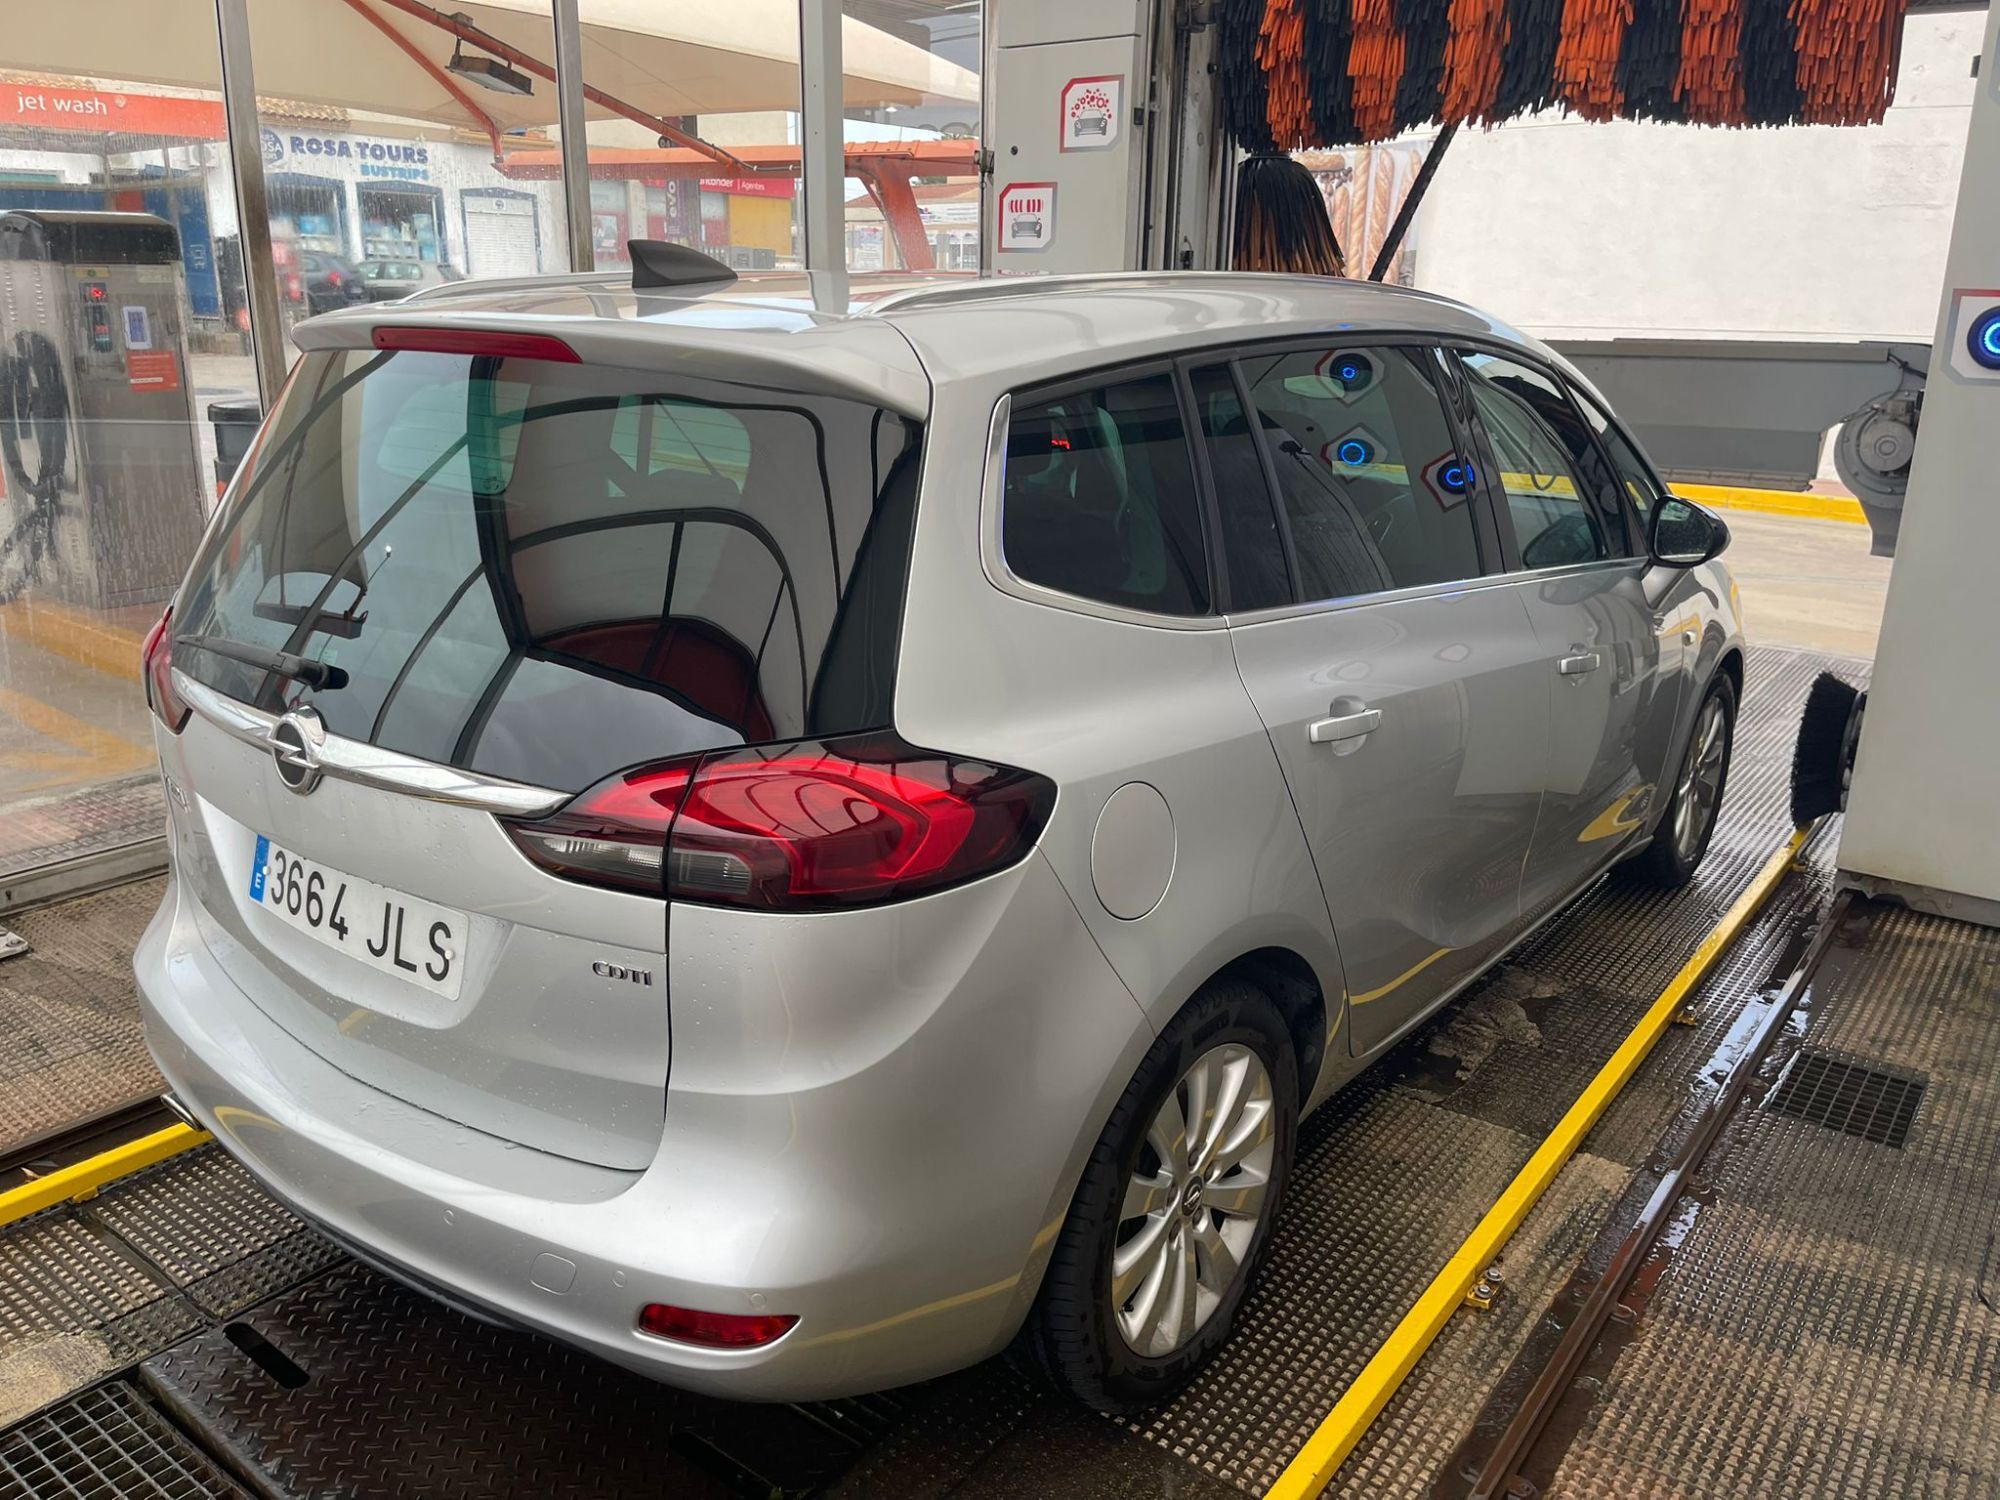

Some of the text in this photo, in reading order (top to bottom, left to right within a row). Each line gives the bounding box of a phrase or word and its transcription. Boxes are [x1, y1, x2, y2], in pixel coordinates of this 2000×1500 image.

[17, 91, 108, 116] jet wash
[290, 136, 429, 164] ROSA TOURS
[255, 872, 263, 889] E
[271, 850, 452, 982] 3664 JLS
